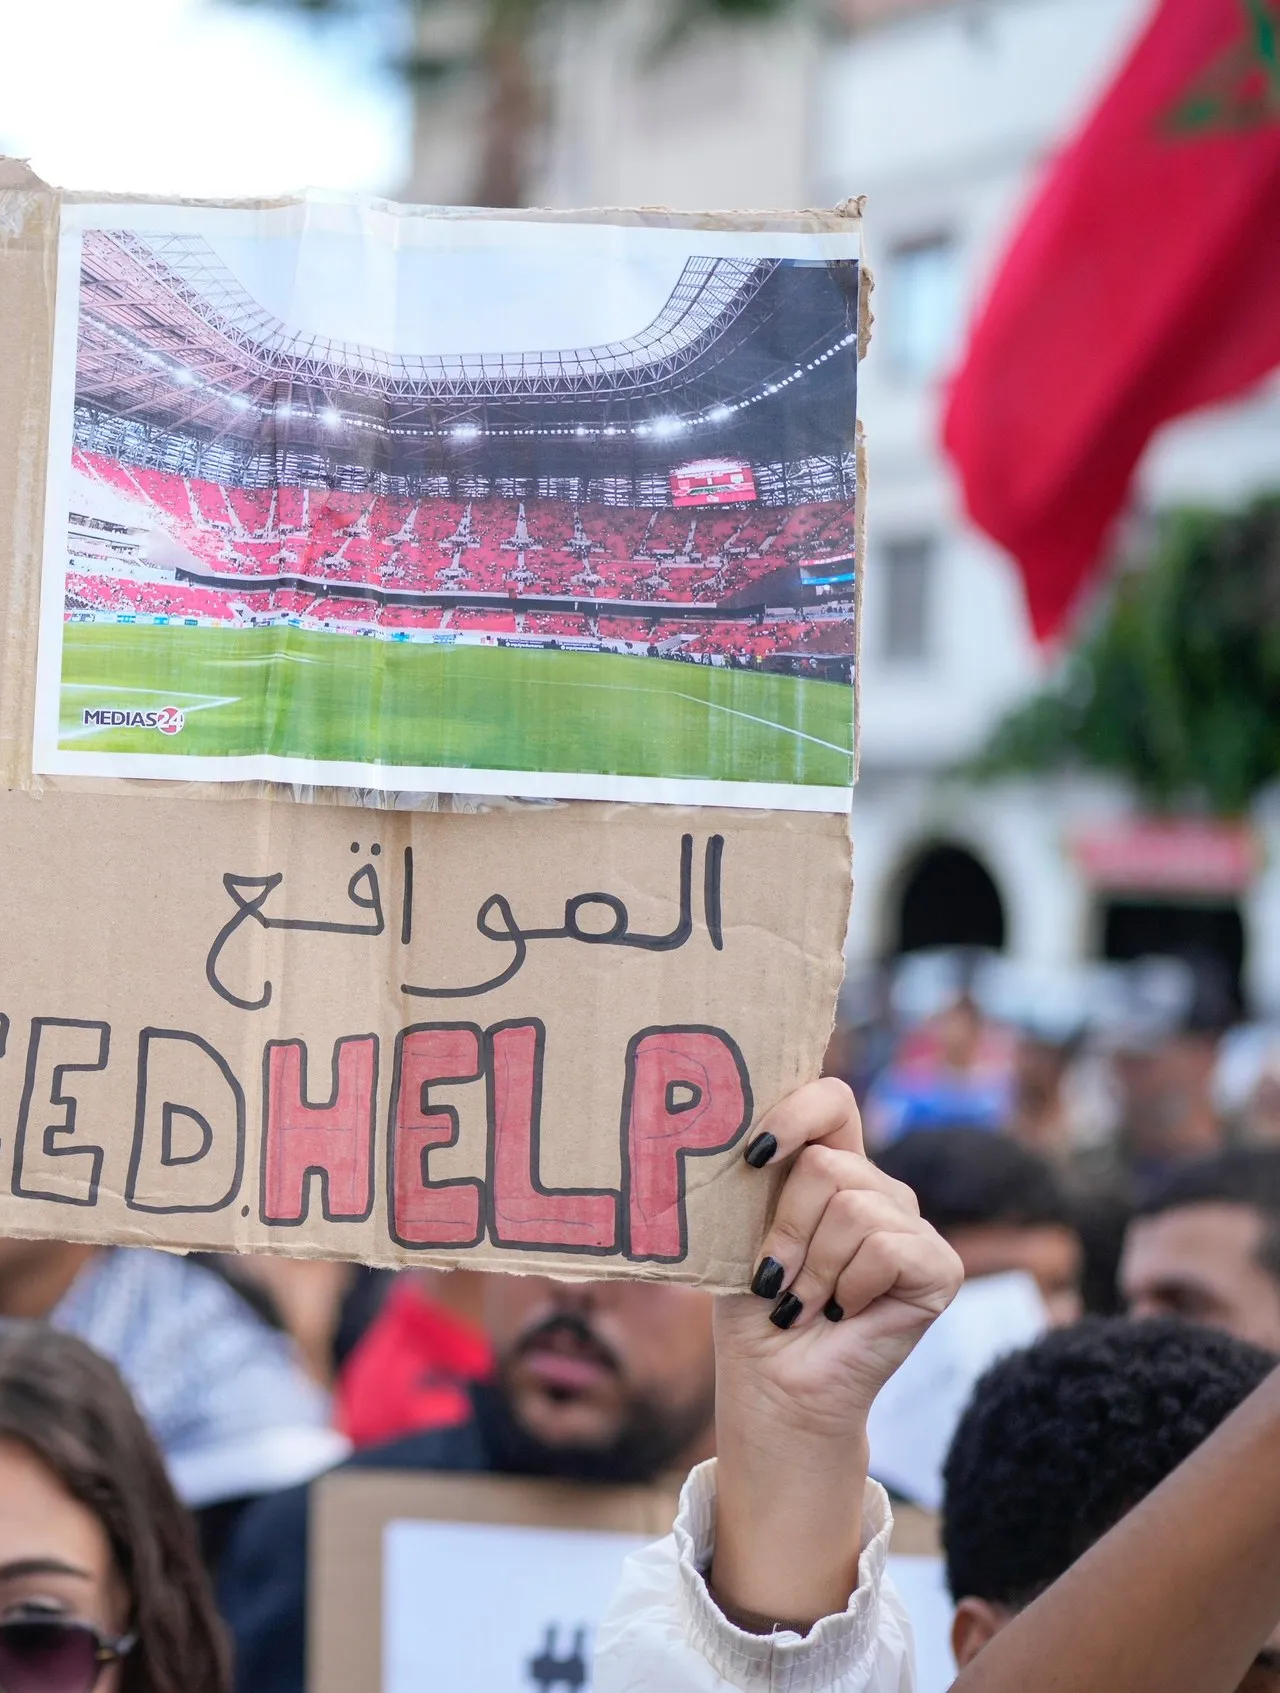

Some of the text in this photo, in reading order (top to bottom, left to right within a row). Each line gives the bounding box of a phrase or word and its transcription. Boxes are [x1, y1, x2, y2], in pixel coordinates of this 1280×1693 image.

[83, 707, 184, 734] MEDIAS24
[206, 833, 724, 1011] المواقع
[260, 1017, 754, 1263] HELP
